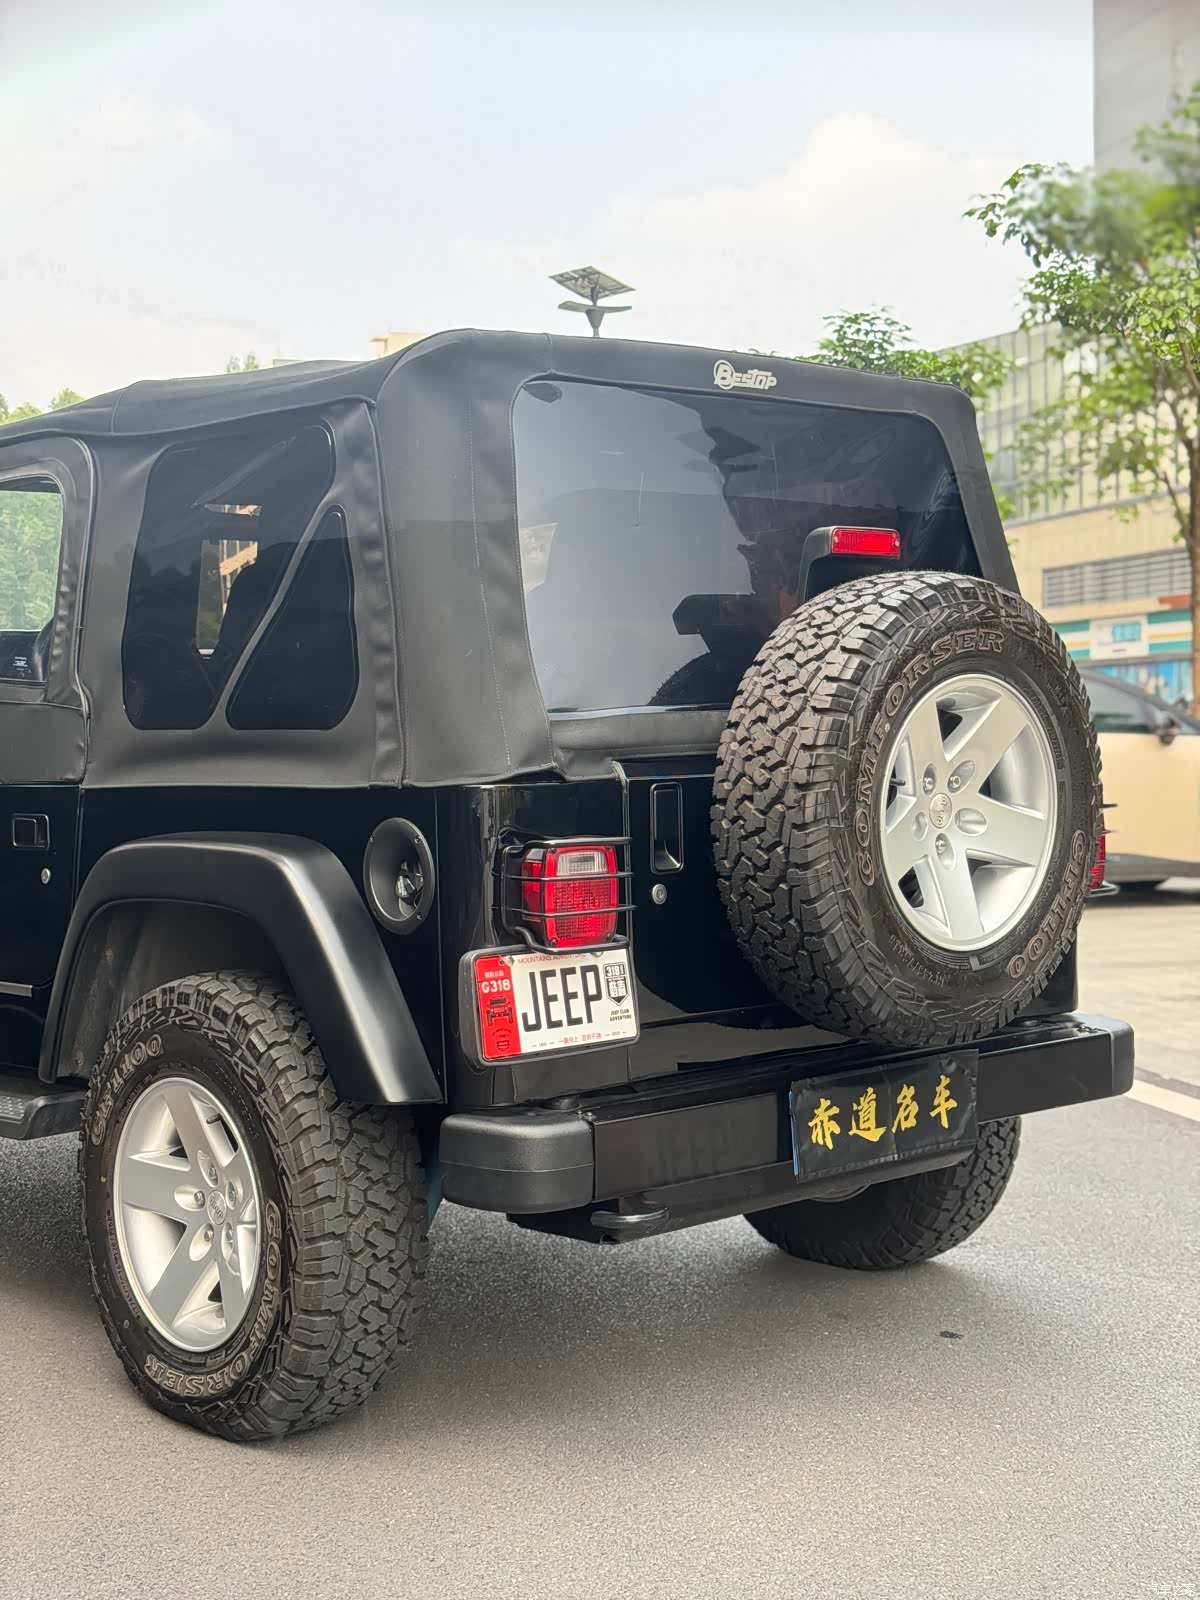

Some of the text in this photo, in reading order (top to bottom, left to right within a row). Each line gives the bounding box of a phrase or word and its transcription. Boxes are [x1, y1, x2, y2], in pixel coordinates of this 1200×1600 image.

[855, 628, 1006, 887] COMFORSER
[481, 978, 511, 994] G318
[521, 964, 603, 1032] JEEP
[808, 1074, 958, 1150] 赤道名车
[144, 1200, 282, 1397] COMFORSER
